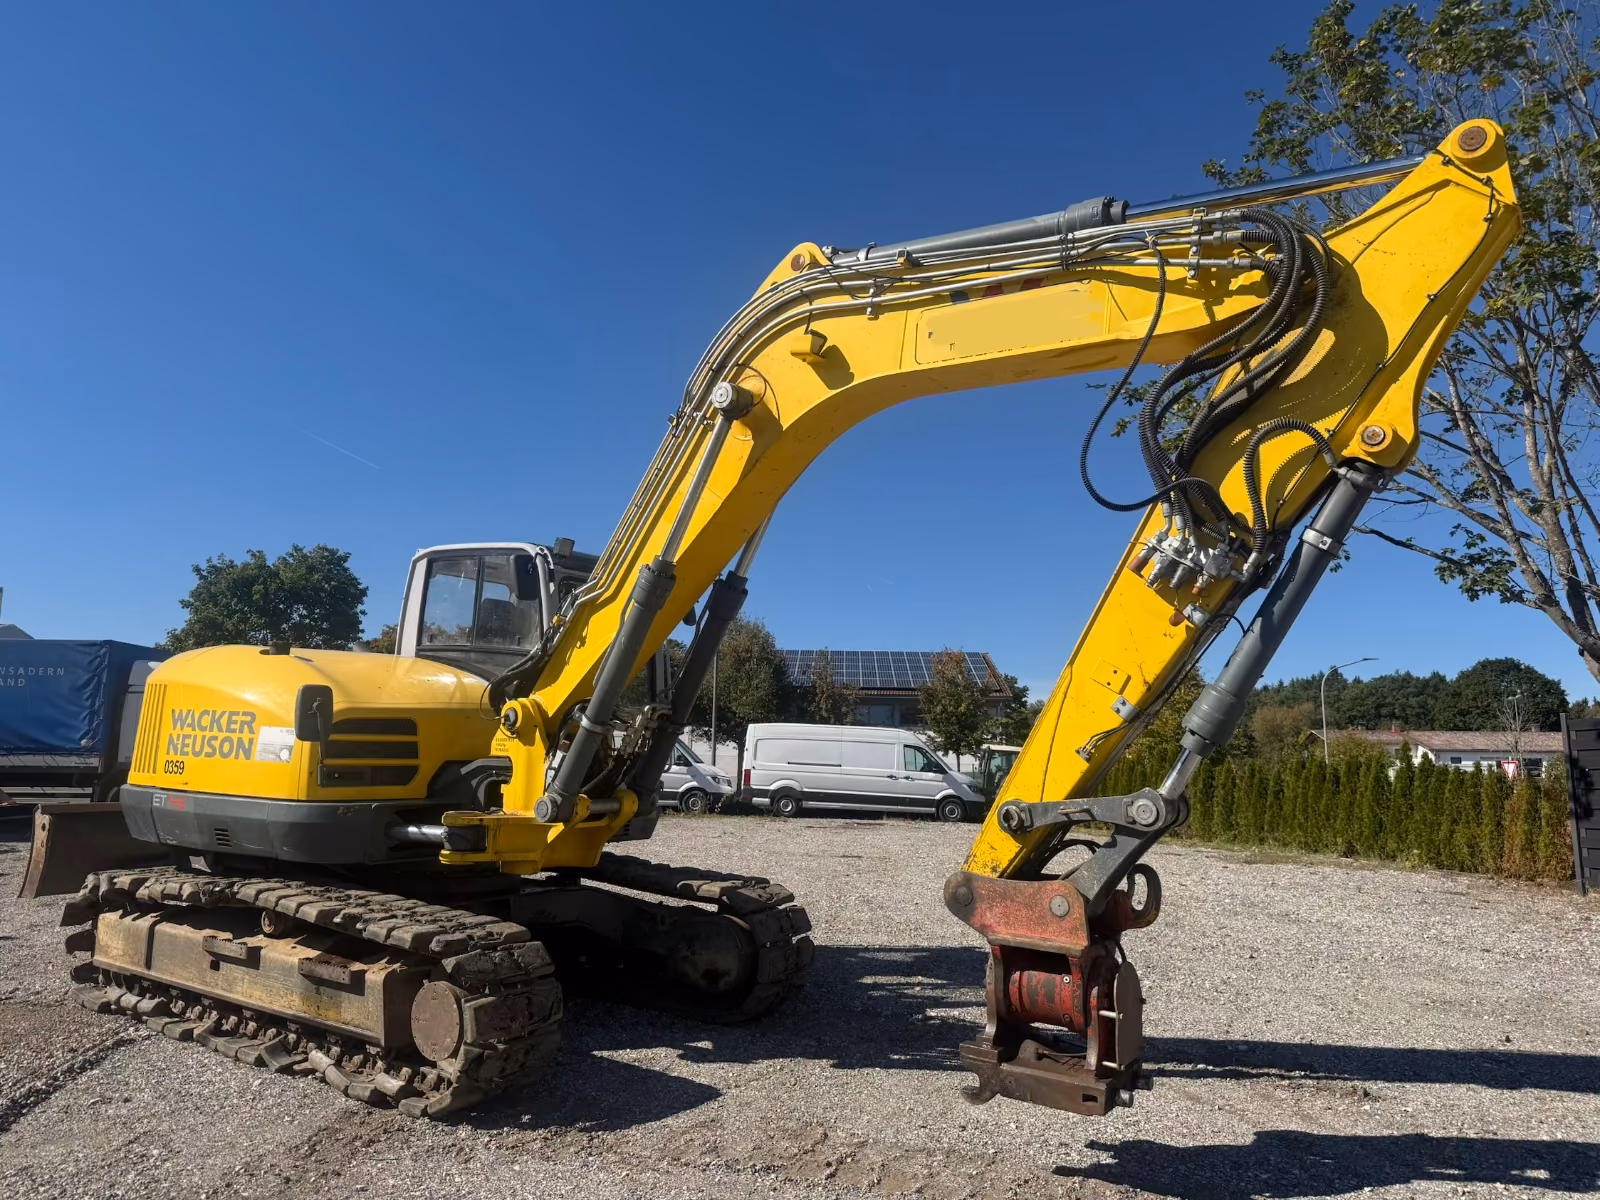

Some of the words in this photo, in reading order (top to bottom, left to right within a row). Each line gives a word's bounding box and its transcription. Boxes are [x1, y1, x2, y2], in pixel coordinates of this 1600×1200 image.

[171, 708, 257, 734] WACKER
[165, 733, 254, 760] NEUSON
[163, 760, 185, 775] 0359
